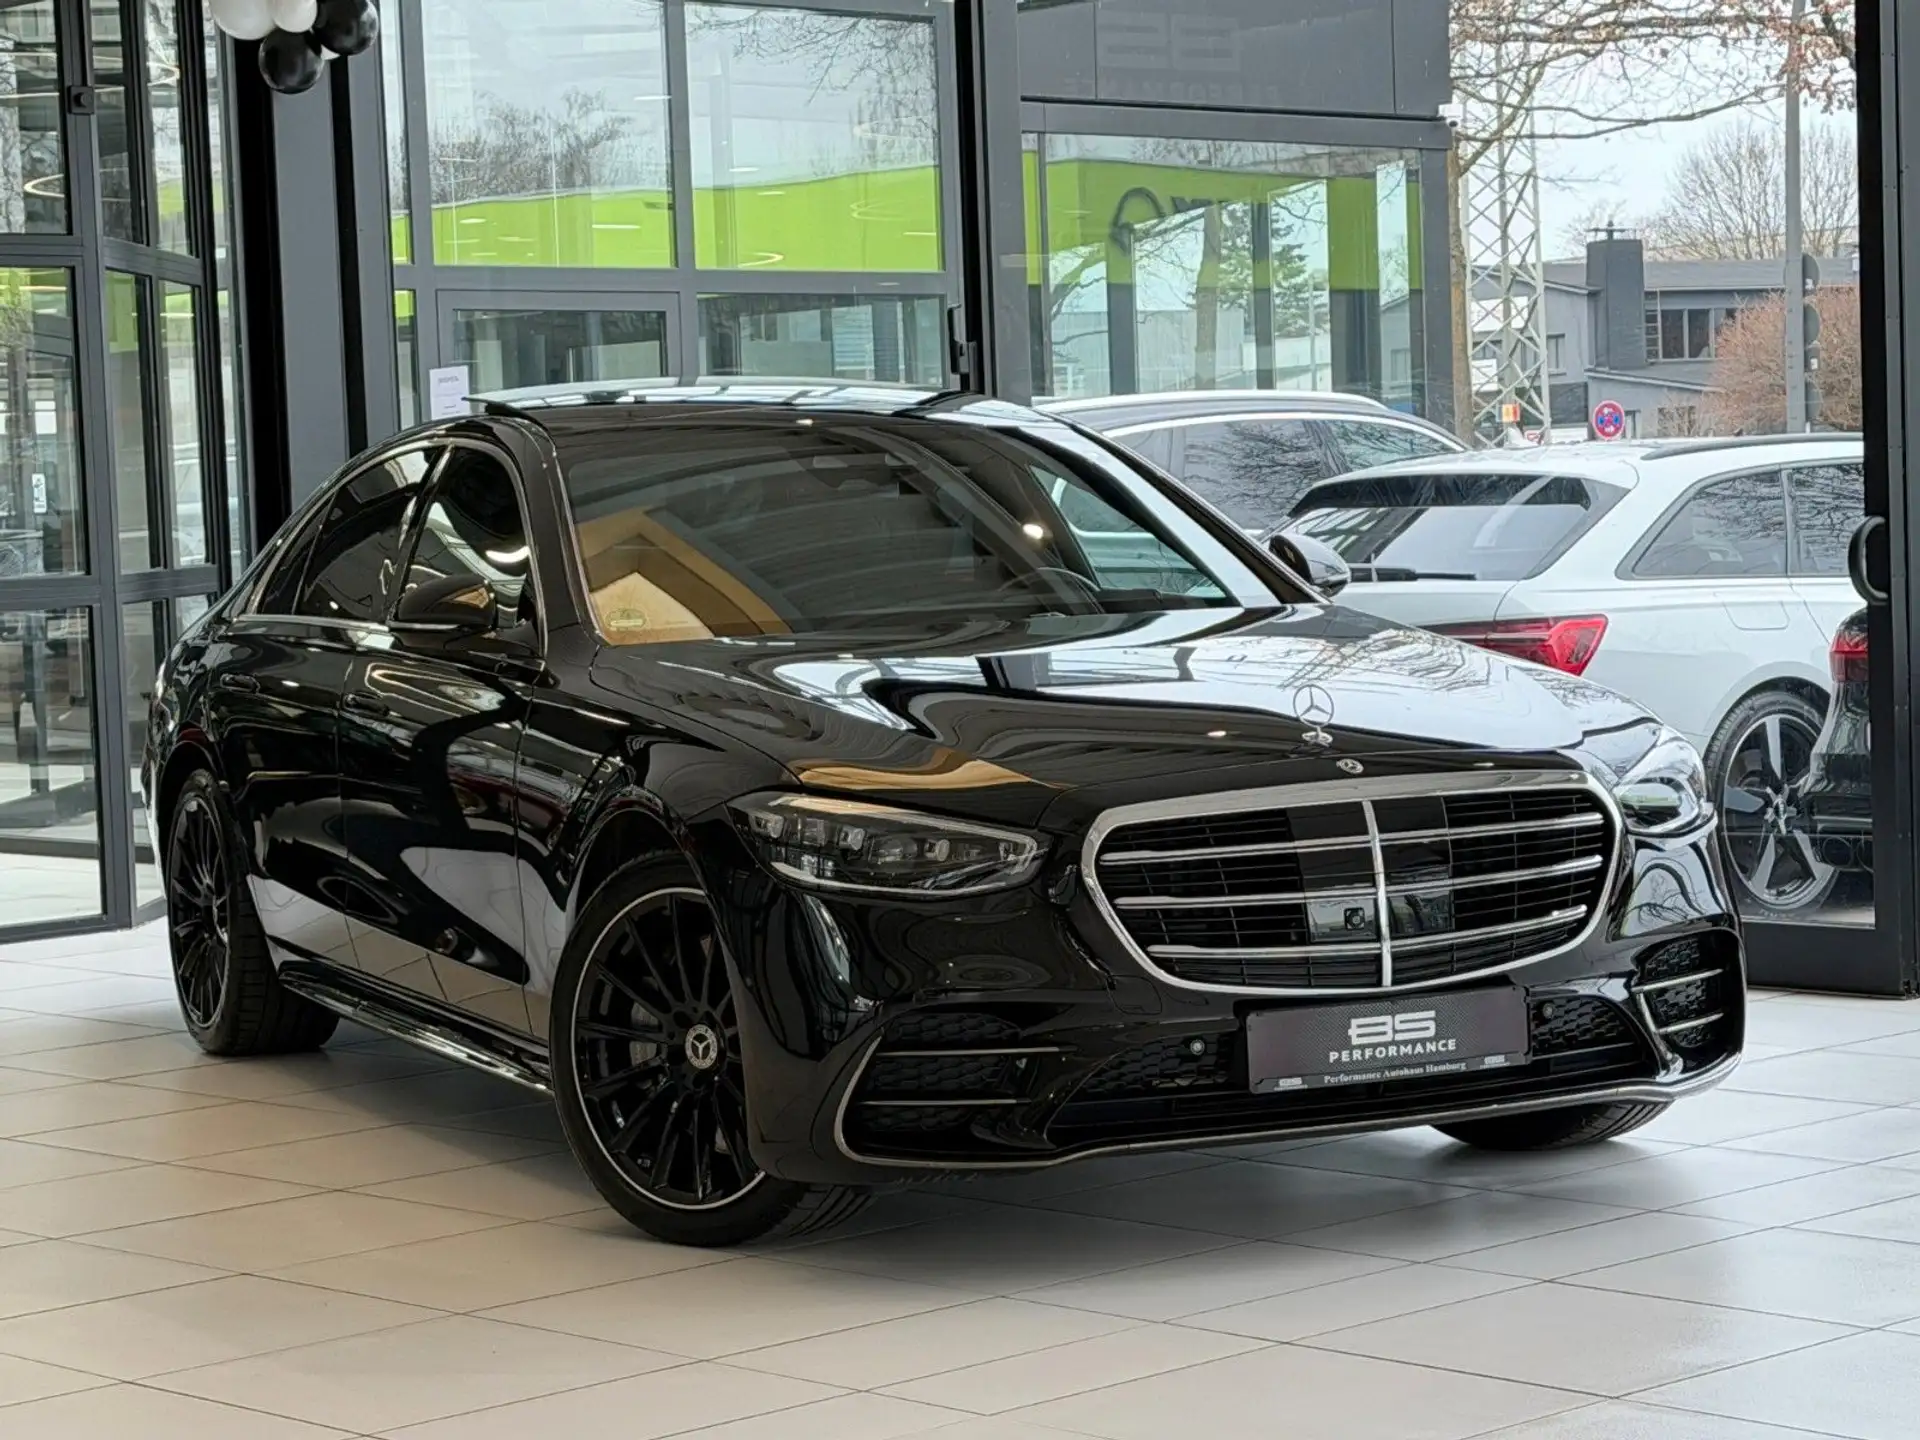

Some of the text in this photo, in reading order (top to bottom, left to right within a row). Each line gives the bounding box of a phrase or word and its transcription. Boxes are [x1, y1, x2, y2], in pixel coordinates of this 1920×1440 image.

[1329, 1039, 1457, 1063] PERFORMANCE
[1323, 1071, 1381, 1084] Performance
[1383, 1066, 1424, 1078] Autohaus
[1425, 1062, 1467, 1074] Hamburg
